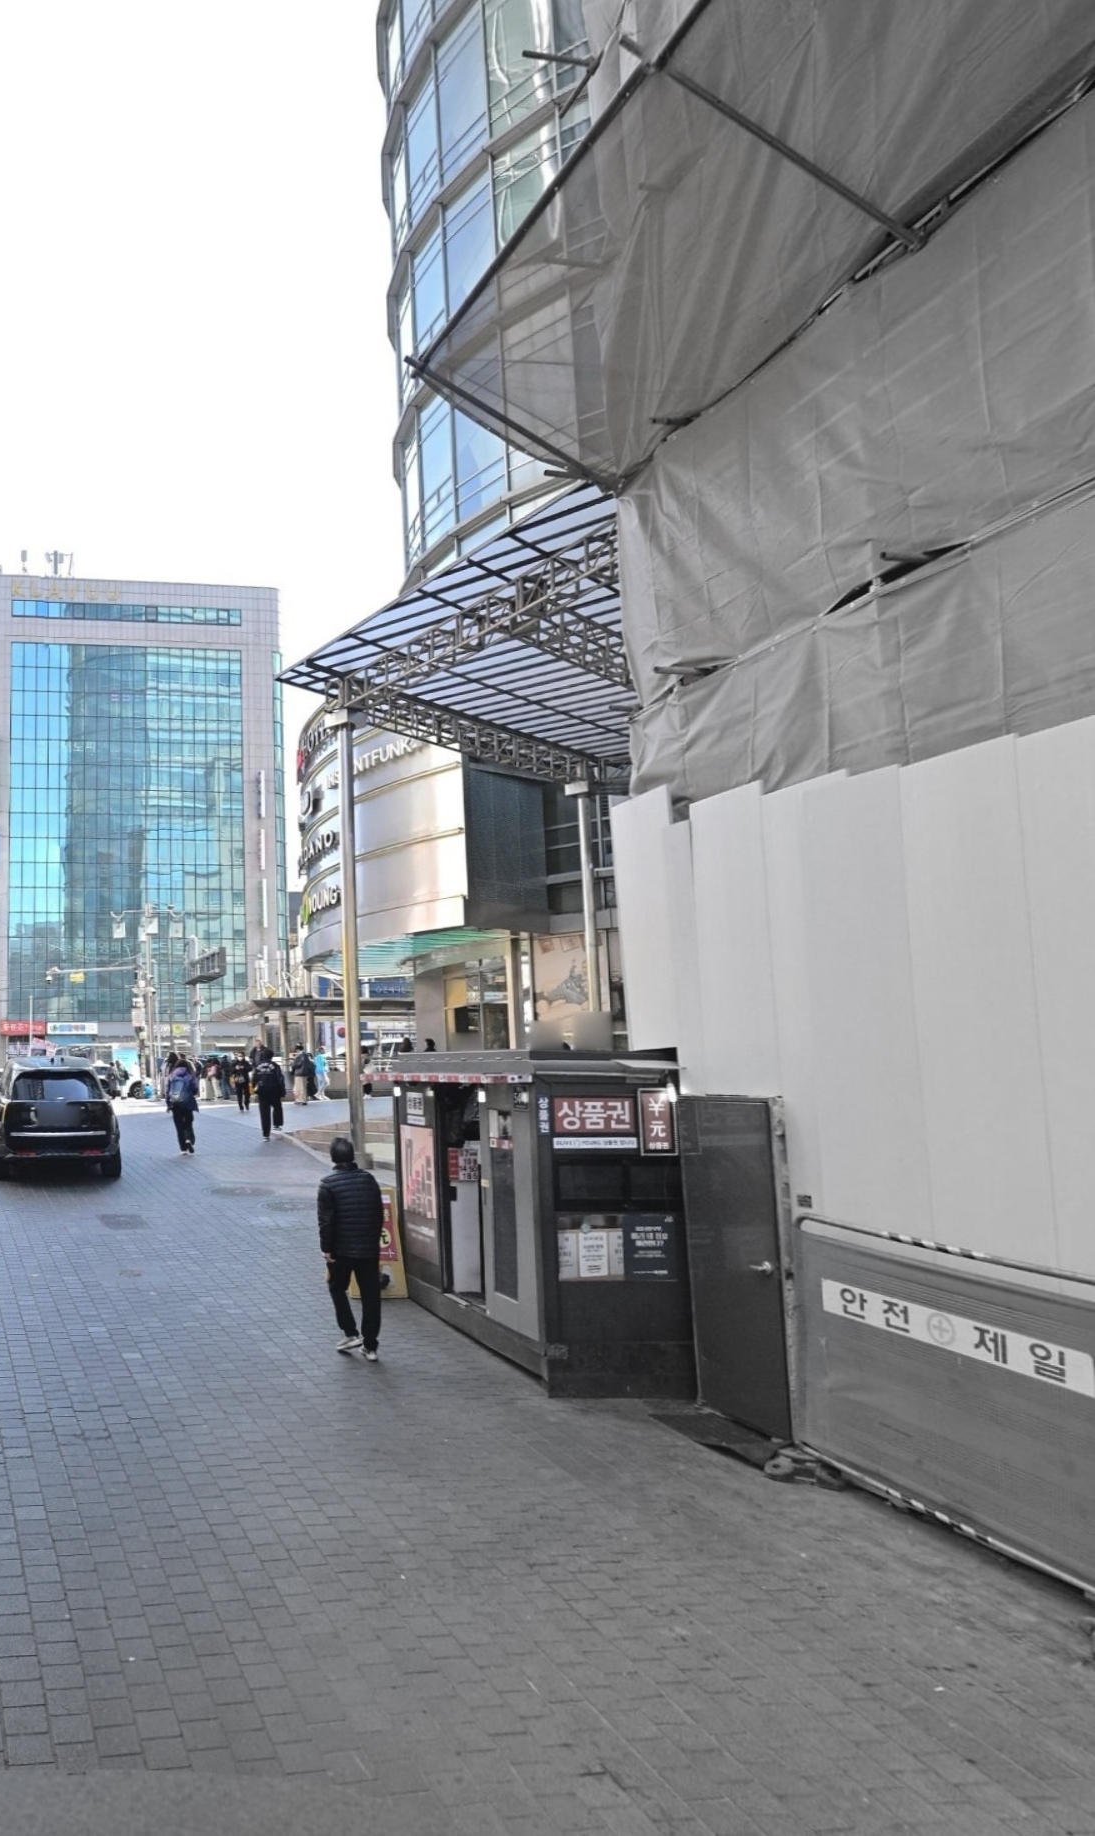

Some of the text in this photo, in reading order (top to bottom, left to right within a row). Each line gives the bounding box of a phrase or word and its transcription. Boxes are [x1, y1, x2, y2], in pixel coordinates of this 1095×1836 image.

[538, 1097, 550, 1133] 상품권
[557, 1101, 631, 1130] 상품권
[649, 1121, 666, 1138] 元
